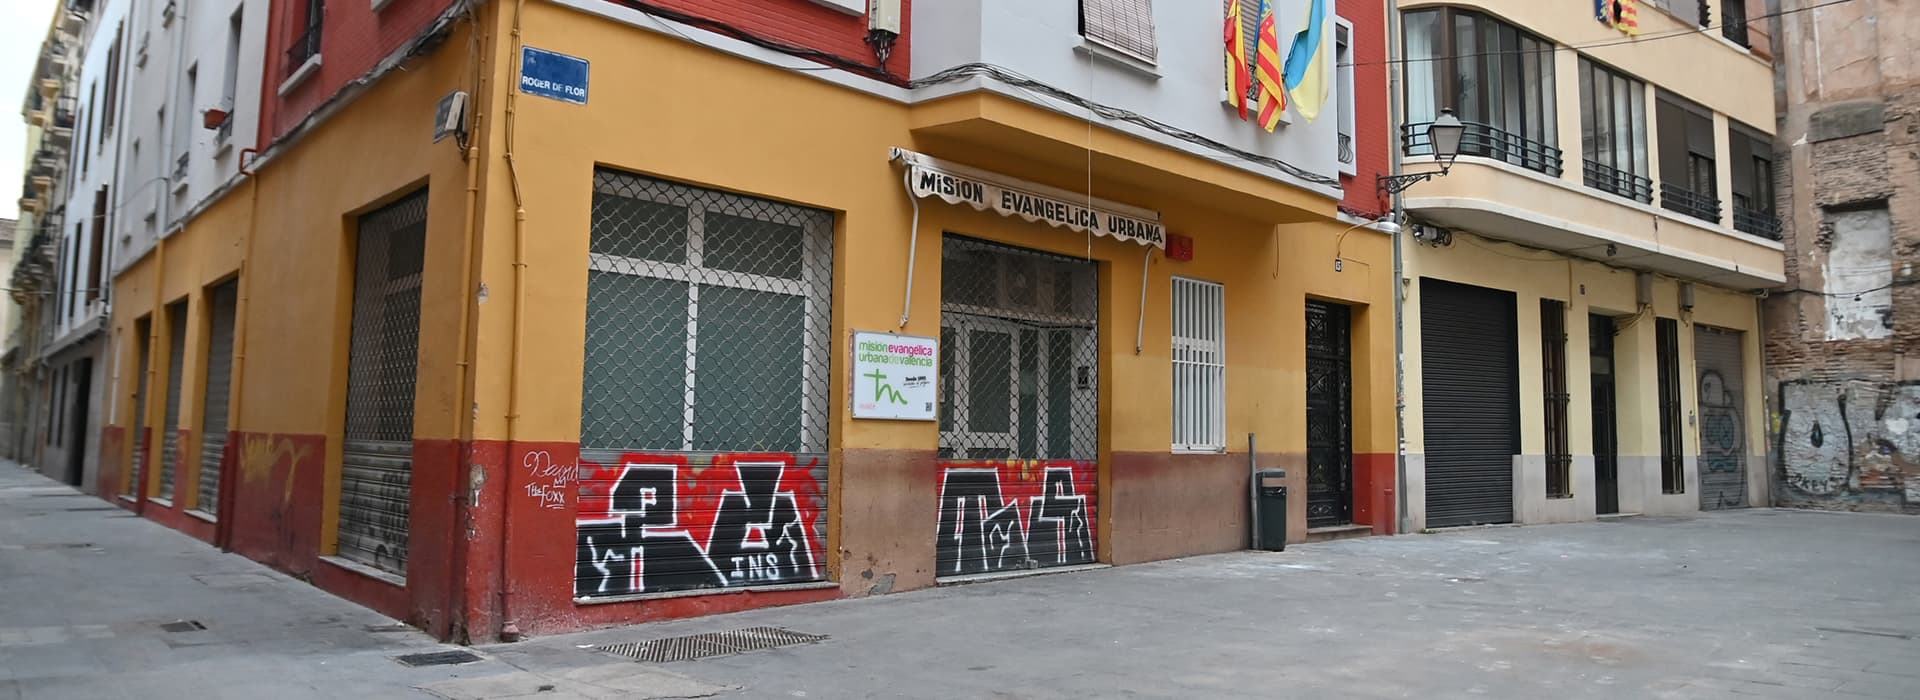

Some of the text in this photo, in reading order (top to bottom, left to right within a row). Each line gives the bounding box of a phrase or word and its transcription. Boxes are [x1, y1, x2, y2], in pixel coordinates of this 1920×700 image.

[522, 76, 551, 89] ROGER
[565, 85, 585, 97] FLOR
[1108, 216, 1163, 243] URBANA
[731, 552, 780, 580] INS
